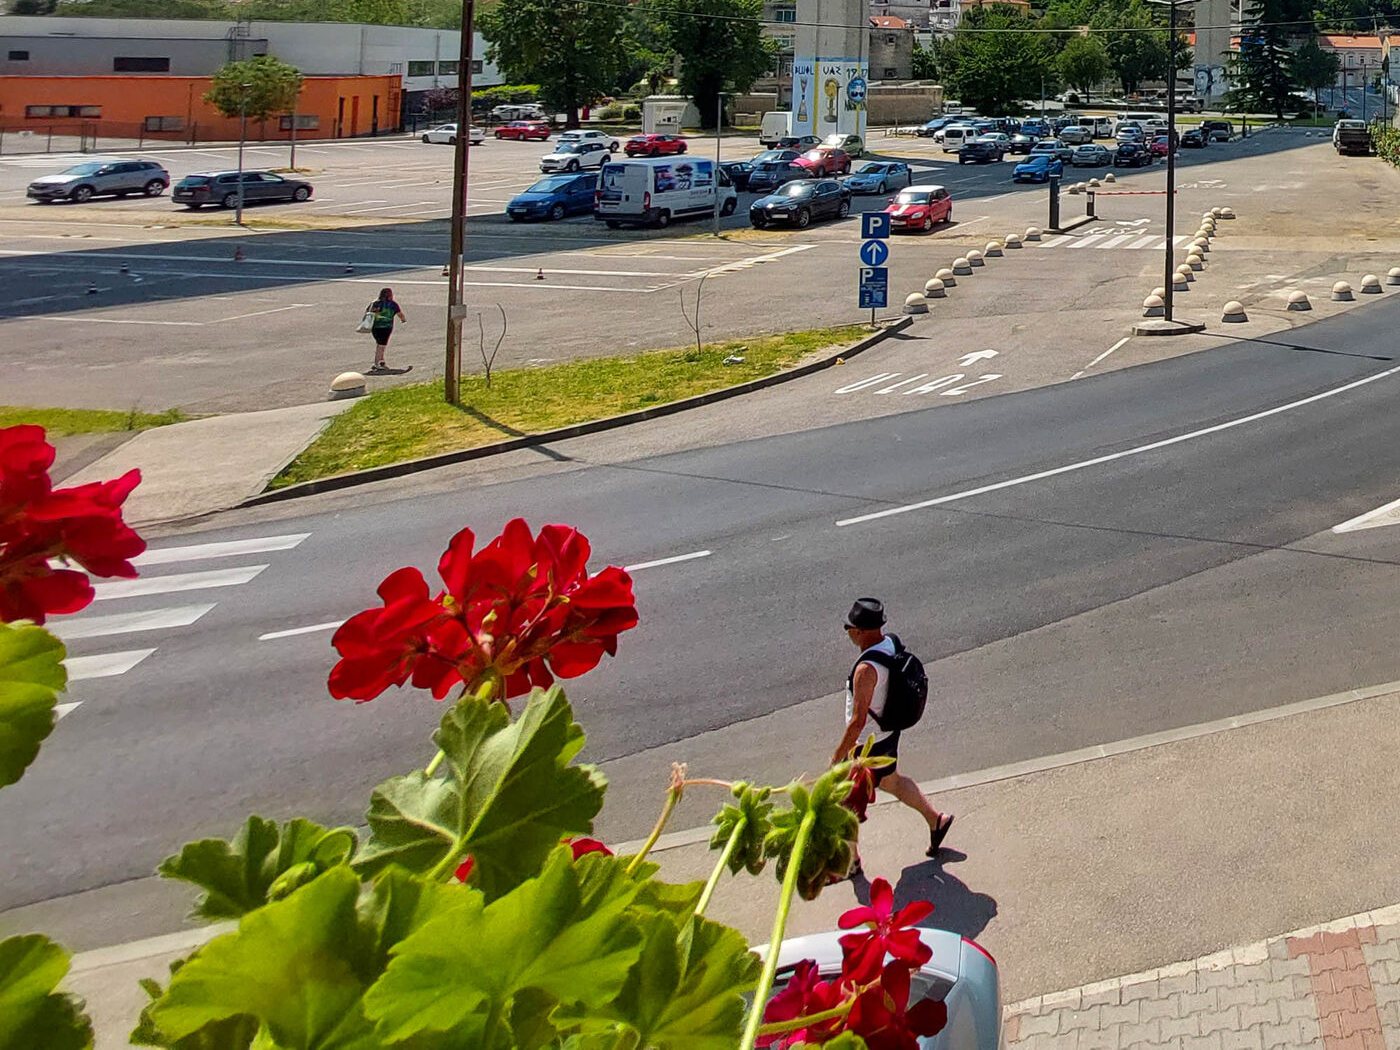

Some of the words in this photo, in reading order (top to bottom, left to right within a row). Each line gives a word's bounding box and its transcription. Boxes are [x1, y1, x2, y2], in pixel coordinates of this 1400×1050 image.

[868, 216, 883, 235] P
[861, 269, 874, 285] P
[834, 372, 1003, 396] ULAZ
